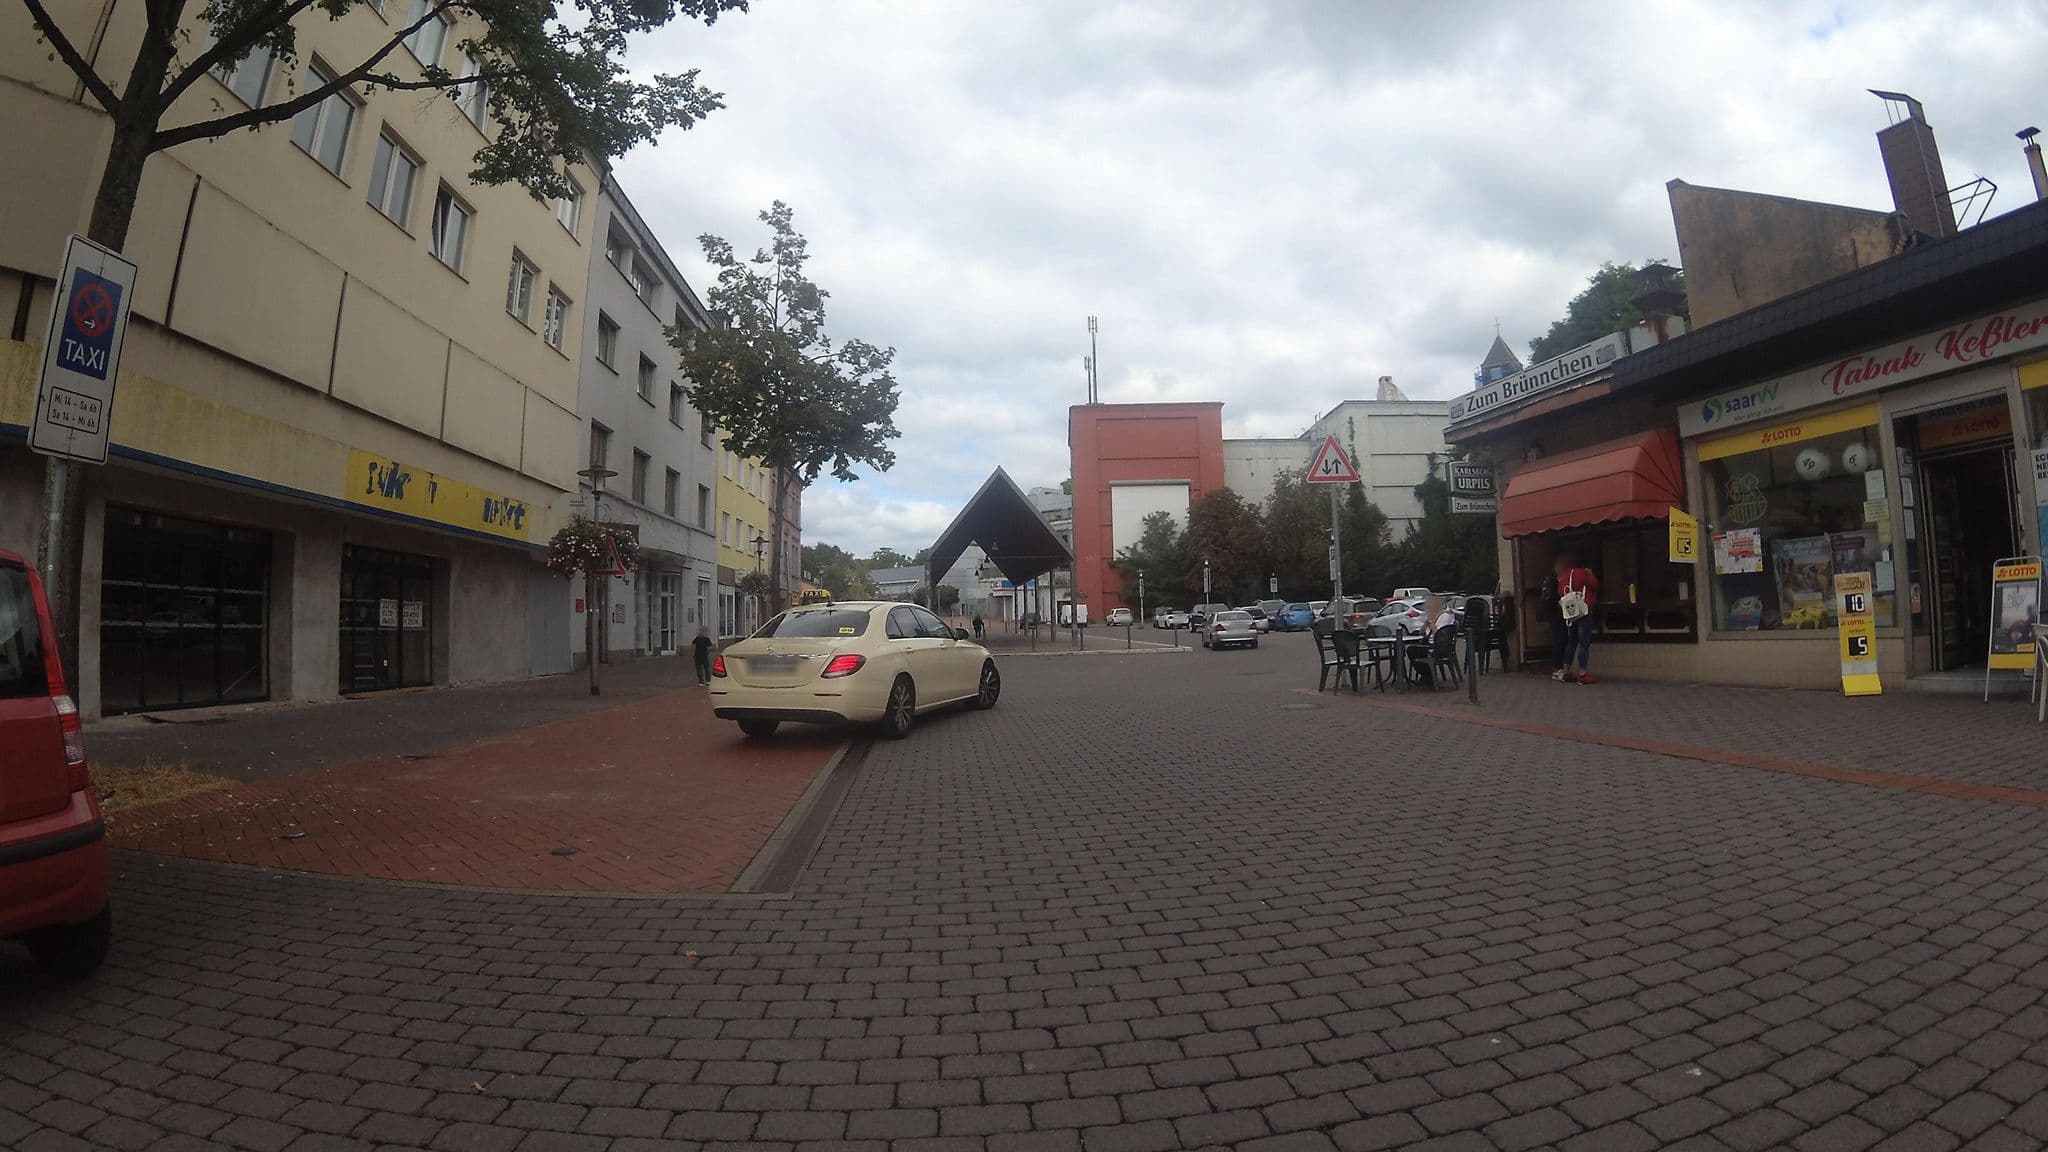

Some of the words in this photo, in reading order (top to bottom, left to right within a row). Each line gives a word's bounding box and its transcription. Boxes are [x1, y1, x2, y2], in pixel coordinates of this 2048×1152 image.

[66, 339, 105, 371] TAXI
[1821, 344, 1926, 395] Tabak
[1935, 313, 2048, 362] Keßler
[1466, 390, 1499, 413] Zum
[1502, 353, 1592, 399] Brünnchen
[64, 395, 71, 407] 14
[79, 400, 88, 411] Sa
[52, 408, 60, 420] Sa
[1773, 426, 1801, 441] LOTTO
[1458, 477, 1490, 489] URPILS
[2008, 566, 2037, 577] LOTTO
[1851, 594, 1865, 612] 10
[1858, 637, 1868, 655] 5
